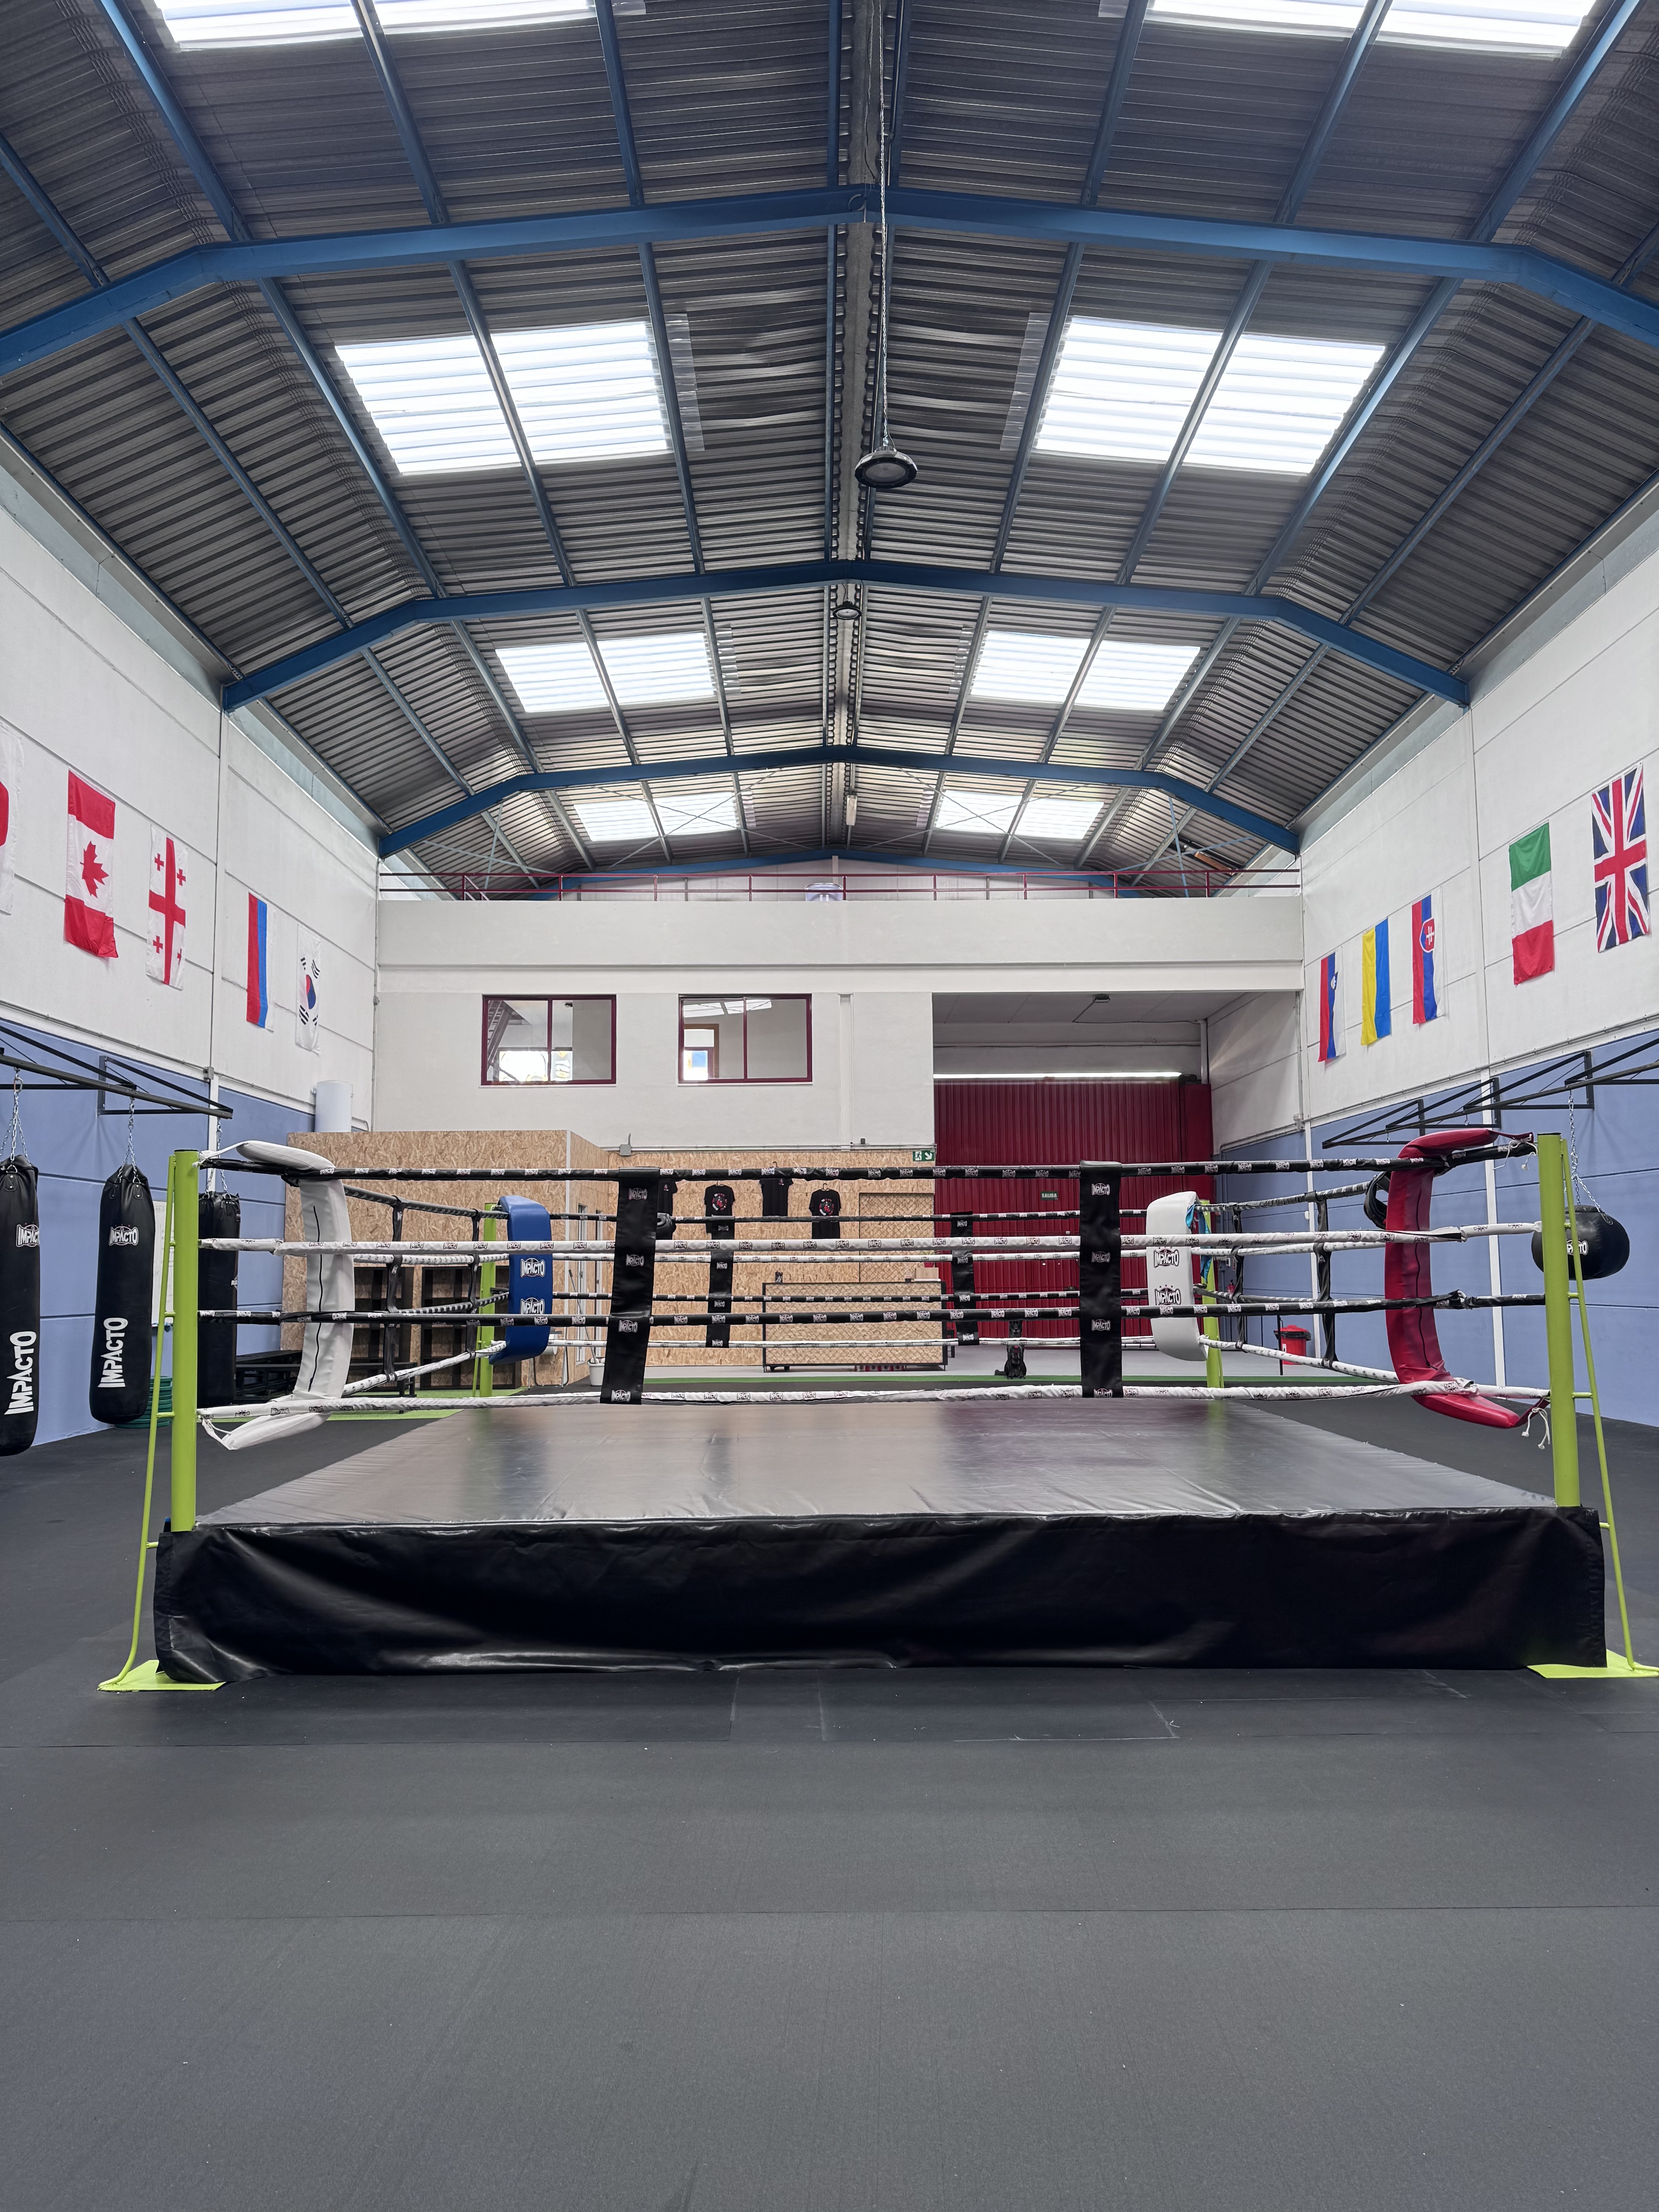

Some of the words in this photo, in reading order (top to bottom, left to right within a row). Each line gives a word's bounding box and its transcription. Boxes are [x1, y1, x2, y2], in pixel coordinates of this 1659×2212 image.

[629, 1188, 647, 1200] IMPACTO
[1091, 1183, 1110, 1195] IMPACTO
[109, 1227, 139, 1245] IMPACTO
[626, 1254, 644, 1266] IMPACTO
[1091, 1251, 1111, 1262] IMPACTO
[1154, 1248, 1180, 1268] IMPACTO
[521, 1258, 545, 1278] IMPACTO
[1155, 1288, 1181, 1306] IMPACTO
[521, 1297, 545, 1314] IMPACTO
[618, 1320, 638, 1333] IMPACTO
[1092, 1319, 1111, 1331] IMPACTO
[98, 1317, 128, 1388] IMPACTO
[4, 1331, 36, 1415] IMPACTO
[611, 1389, 631, 1402] IMPACTO
